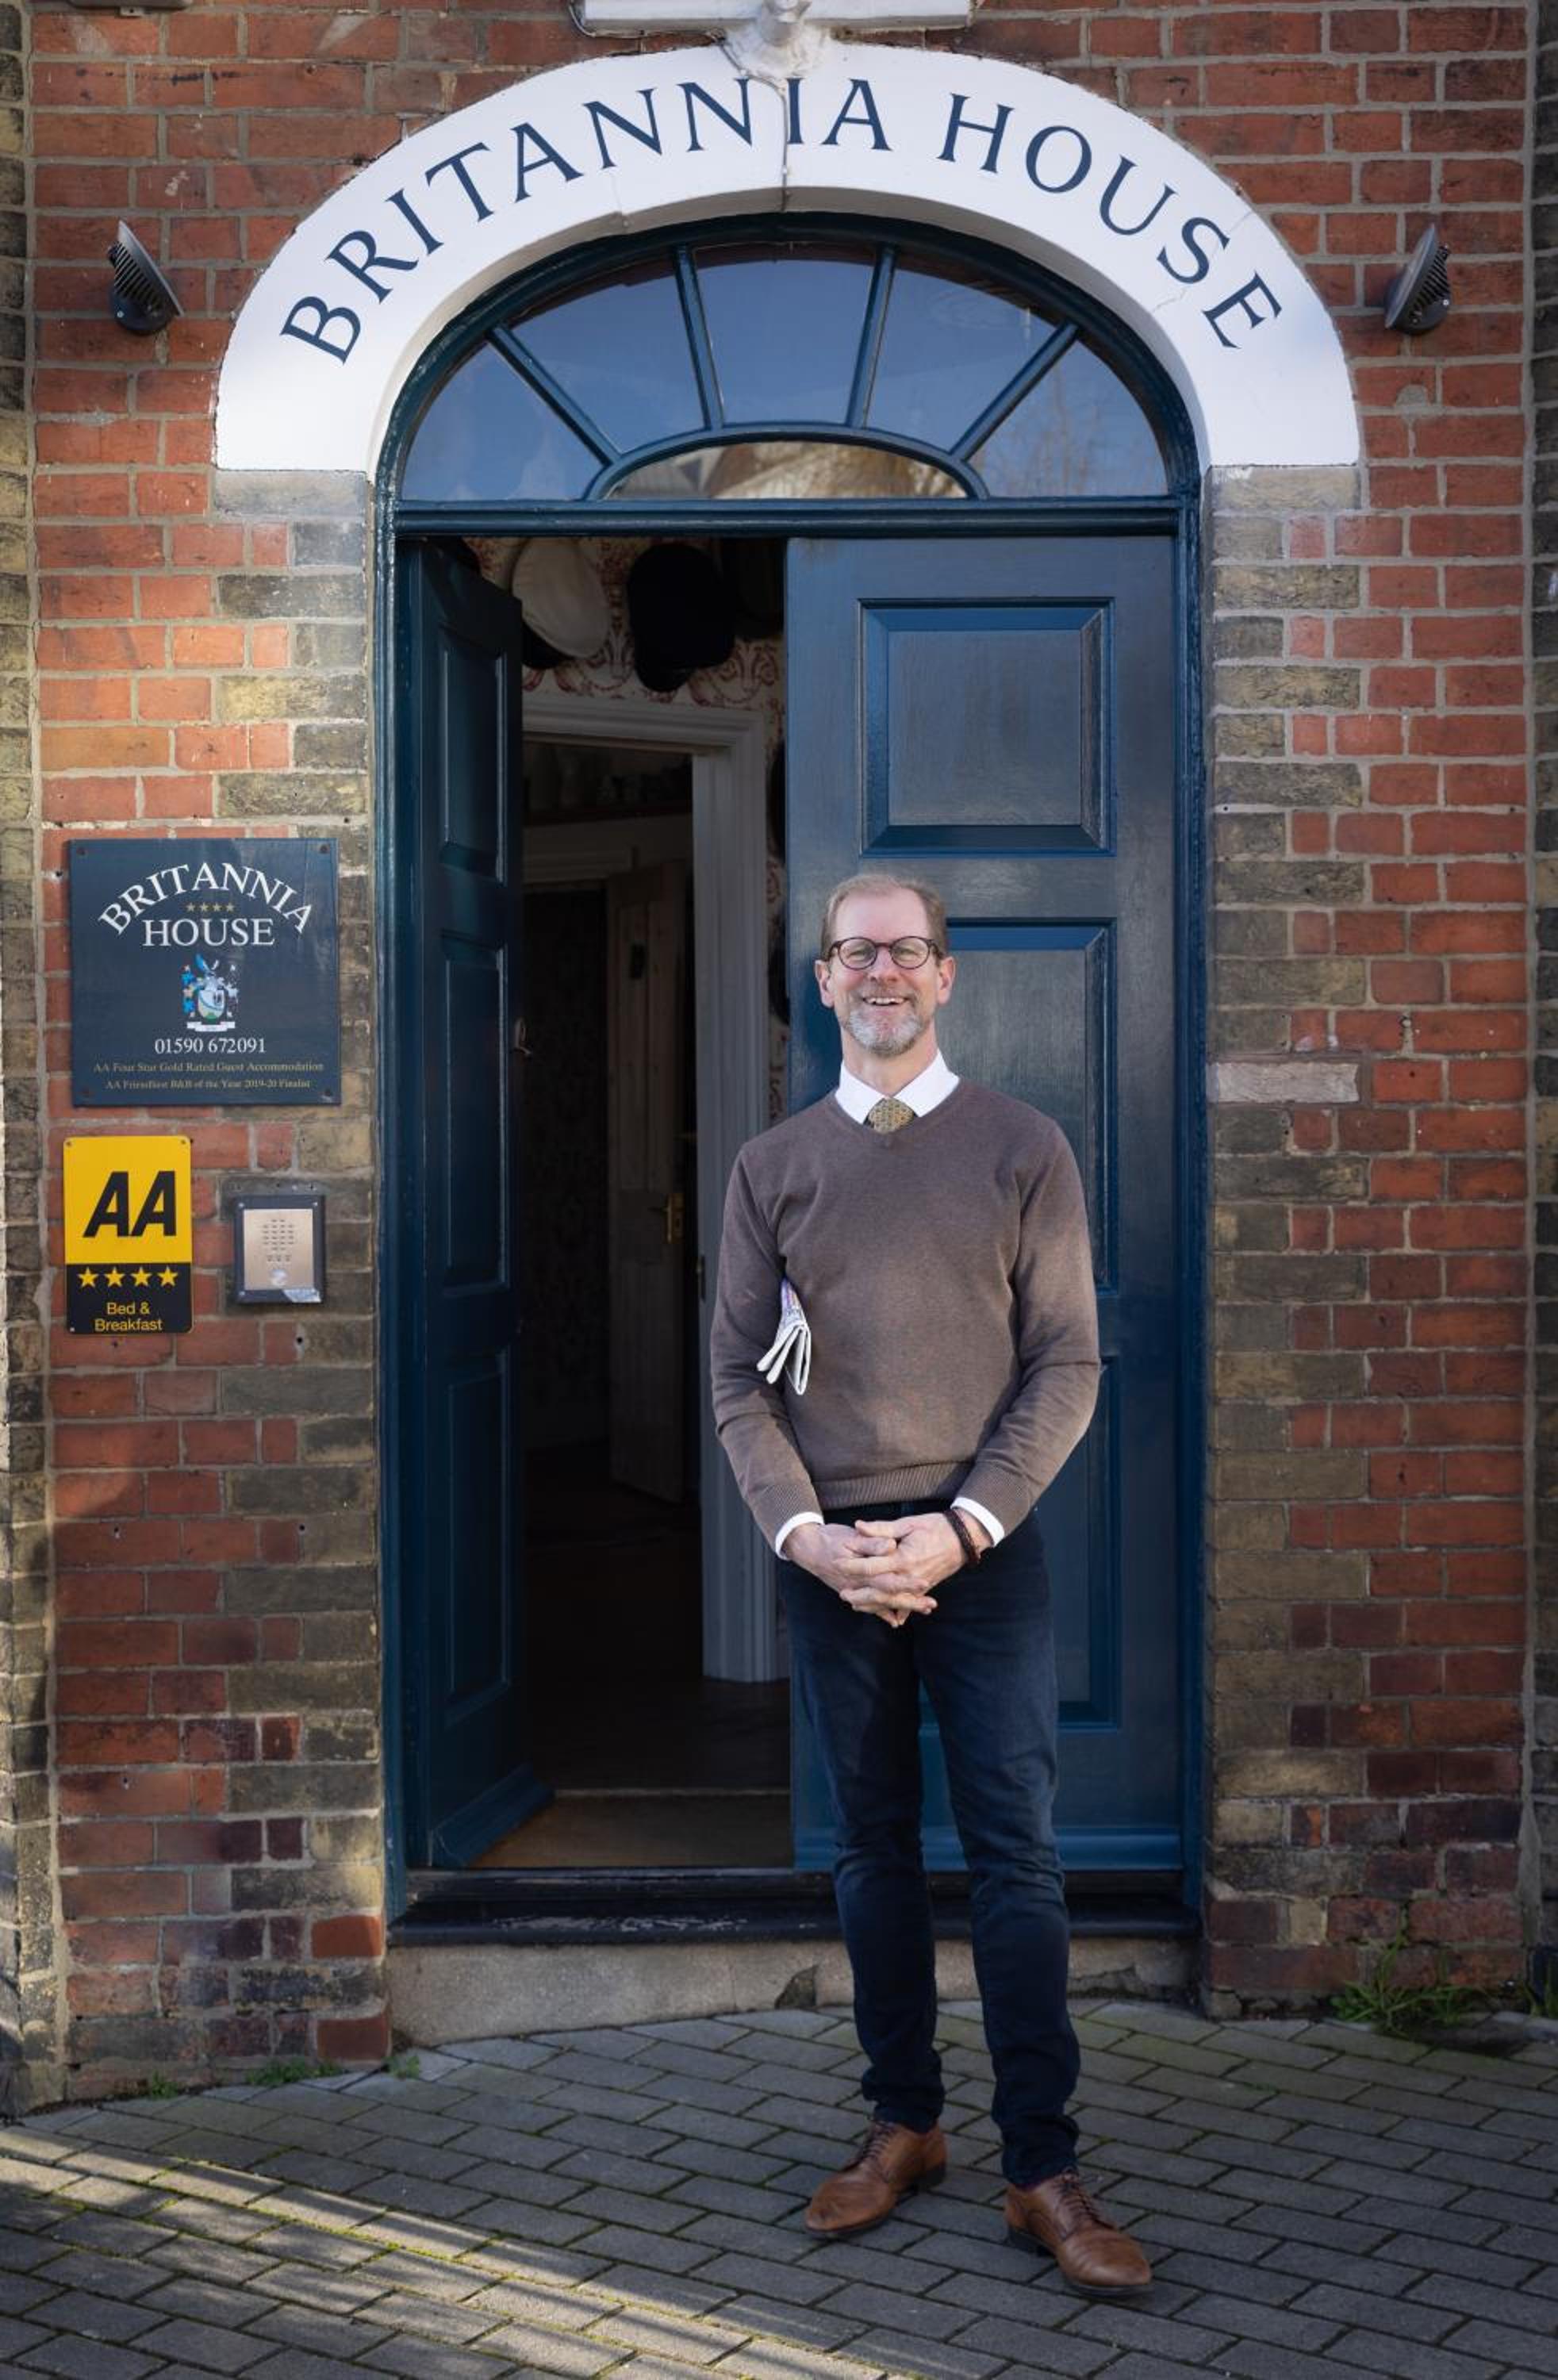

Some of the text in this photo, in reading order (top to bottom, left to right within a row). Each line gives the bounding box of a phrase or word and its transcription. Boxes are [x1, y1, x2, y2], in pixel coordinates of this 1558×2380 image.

[280, 78, 1283, 365] BRITANNIA HOUSE
[98, 862, 313, 935] BRITANNIA
[142, 917, 275, 947] HOUSE
[155, 1037, 267, 1054] 01590 672091
[83, 1170, 177, 1238] AA
[106, 1301, 151, 1315] Bed &
[94, 1317, 163, 1332] Breakfast
